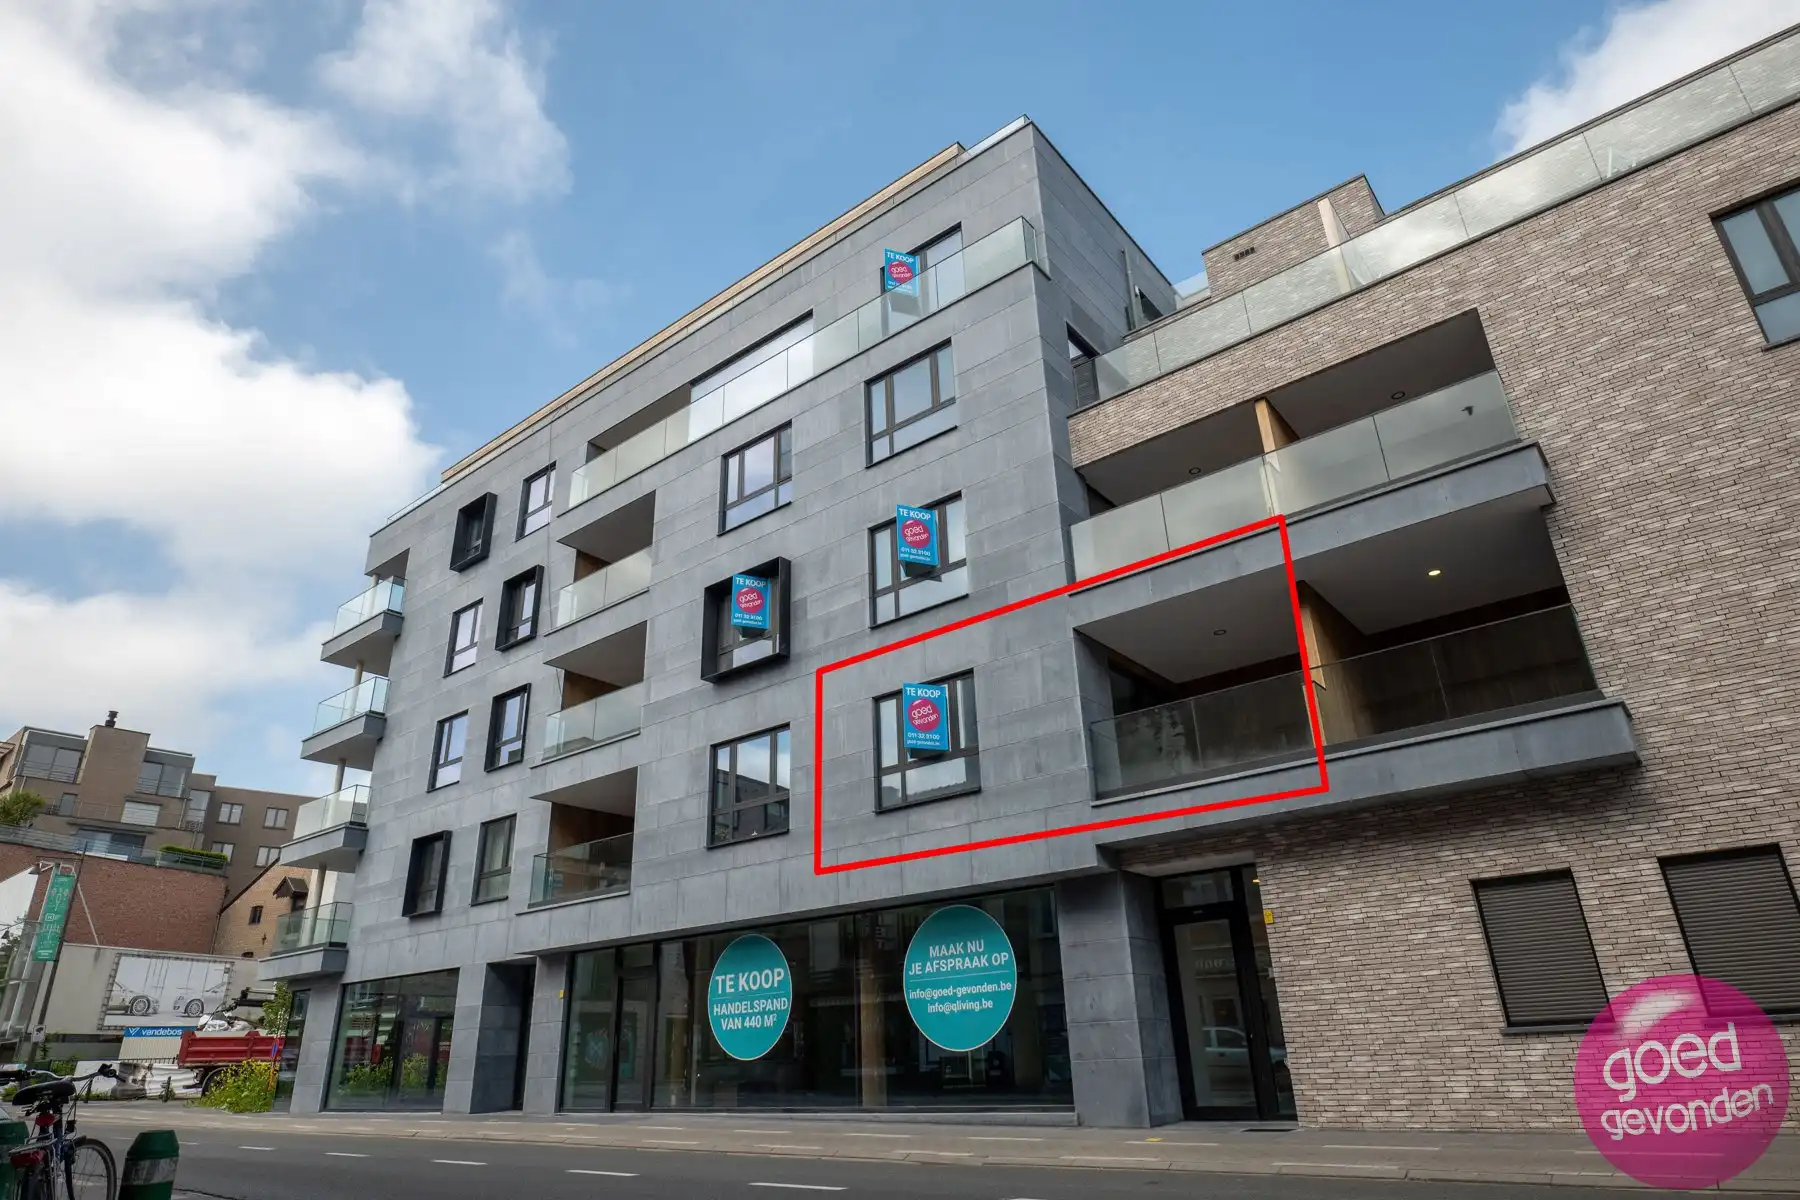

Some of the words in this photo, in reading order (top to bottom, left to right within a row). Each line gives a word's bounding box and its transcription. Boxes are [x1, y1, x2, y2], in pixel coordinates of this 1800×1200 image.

[886, 251, 895, 259] TE
[895, 254, 914, 263] KOOP
[898, 508, 908, 517] TE
[910, 510, 931, 520] KOOP
[904, 525, 924, 536] goed
[735, 577, 744, 585] TE
[745, 579, 766, 588] KOOP
[739, 592, 758, 603] goed
[905, 687, 916, 696] TE
[917, 688, 941, 698] KOOP
[911, 704, 932, 719] goed
[912, 714, 939, 725] gevonden
[929, 942, 964, 958] MAAK
[967, 939, 984, 953] NU
[909, 962, 922, 976] JE
[925, 954, 989, 973] AFSPRAAK
[991, 952, 1009, 966] OP
[715, 974, 734, 994] TE
[738, 968, 785, 992] KOOP
[909, 981, 1012, 1000] info@goed-gevonden.be
[713, 997, 788, 1016] HANDELSPAND
[928, 999, 993, 1014] info@qliving.be
[721, 1017, 742, 1030] VAN
[744, 1015, 761, 1028] 440
[764, 1014, 777, 1027] M²
